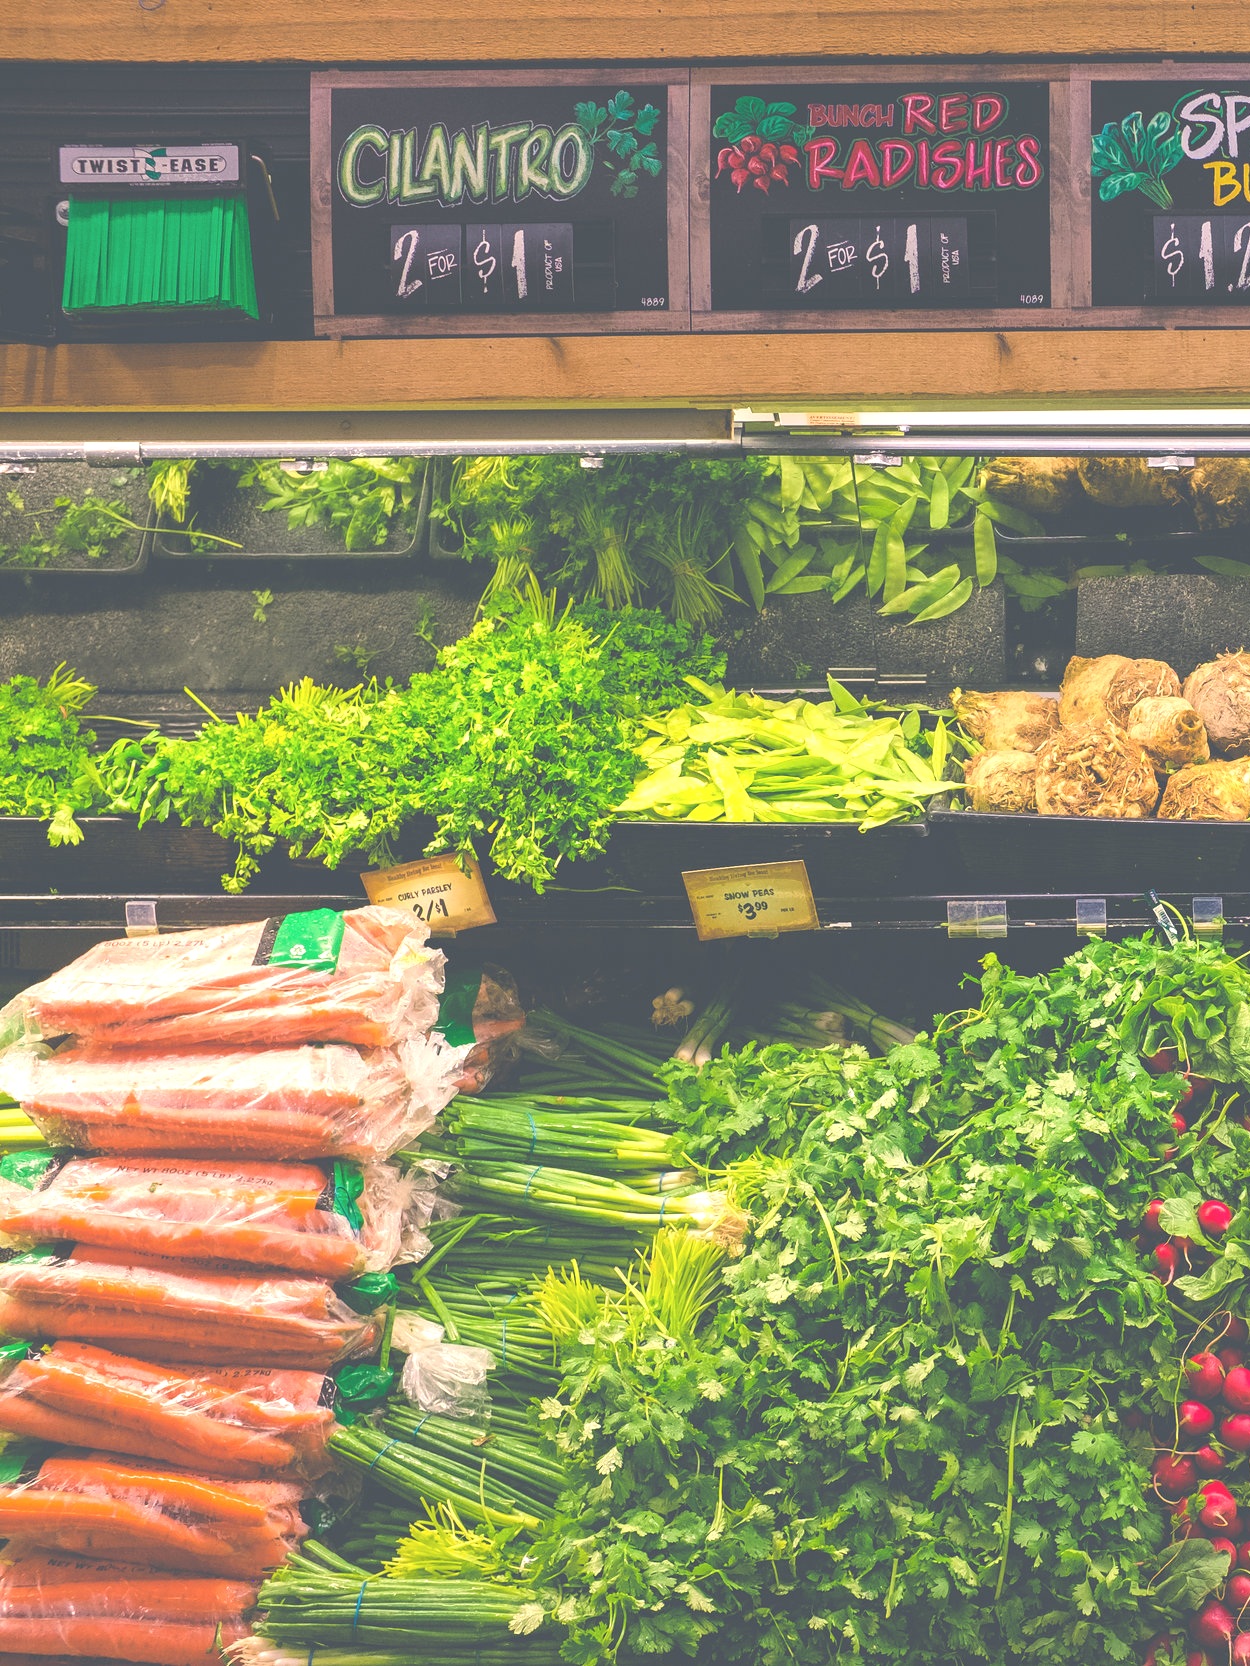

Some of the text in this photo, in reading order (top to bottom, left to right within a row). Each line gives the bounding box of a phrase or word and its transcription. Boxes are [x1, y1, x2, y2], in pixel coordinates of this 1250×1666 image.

[807, 91, 1009, 136] BUNCH RED
[77, 159, 140, 172] TWIST
[338, 121, 593, 207] CILANTRO
[803, 134, 1044, 191] RADISHES
[394, 229, 422, 298] 2
[428, 253, 457, 277] FOR
[794, 224, 822, 293] 2
[828, 246, 857, 268] FOR
[398, 883, 452, 902] CURLY PARSLEY
[724, 891, 749, 901] SNOW
[752, 888, 775, 897] PEAS
